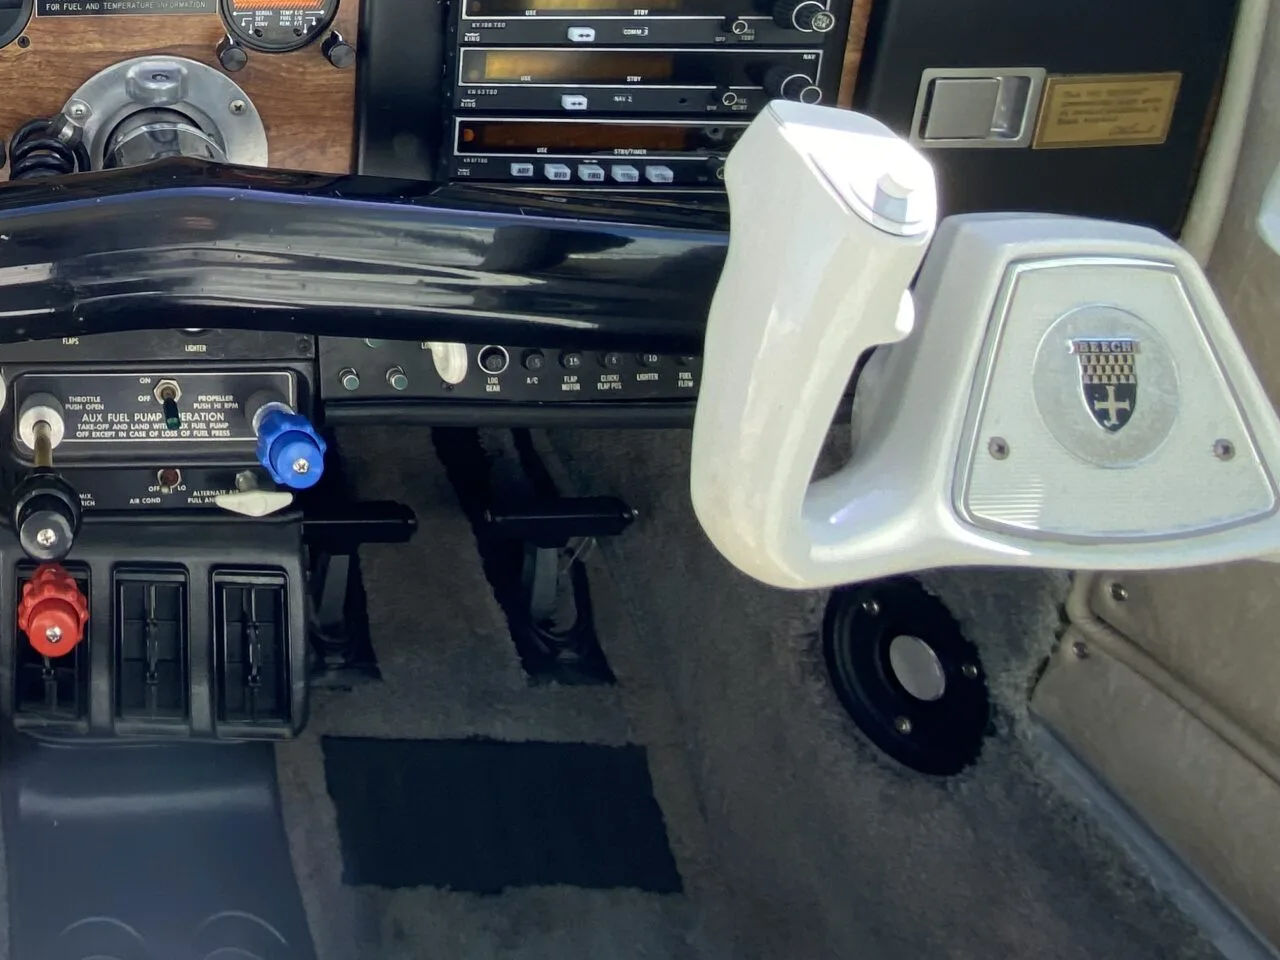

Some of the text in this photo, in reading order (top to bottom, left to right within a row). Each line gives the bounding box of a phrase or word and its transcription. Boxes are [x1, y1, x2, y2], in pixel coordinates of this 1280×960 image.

[46, 2, 60, 10] FOR
[63, 2, 82, 10] FUEL
[1079, 341, 1132, 352] BEECH
[486, 384, 500, 392] GEAR
[82, 414, 103, 422] AUX
